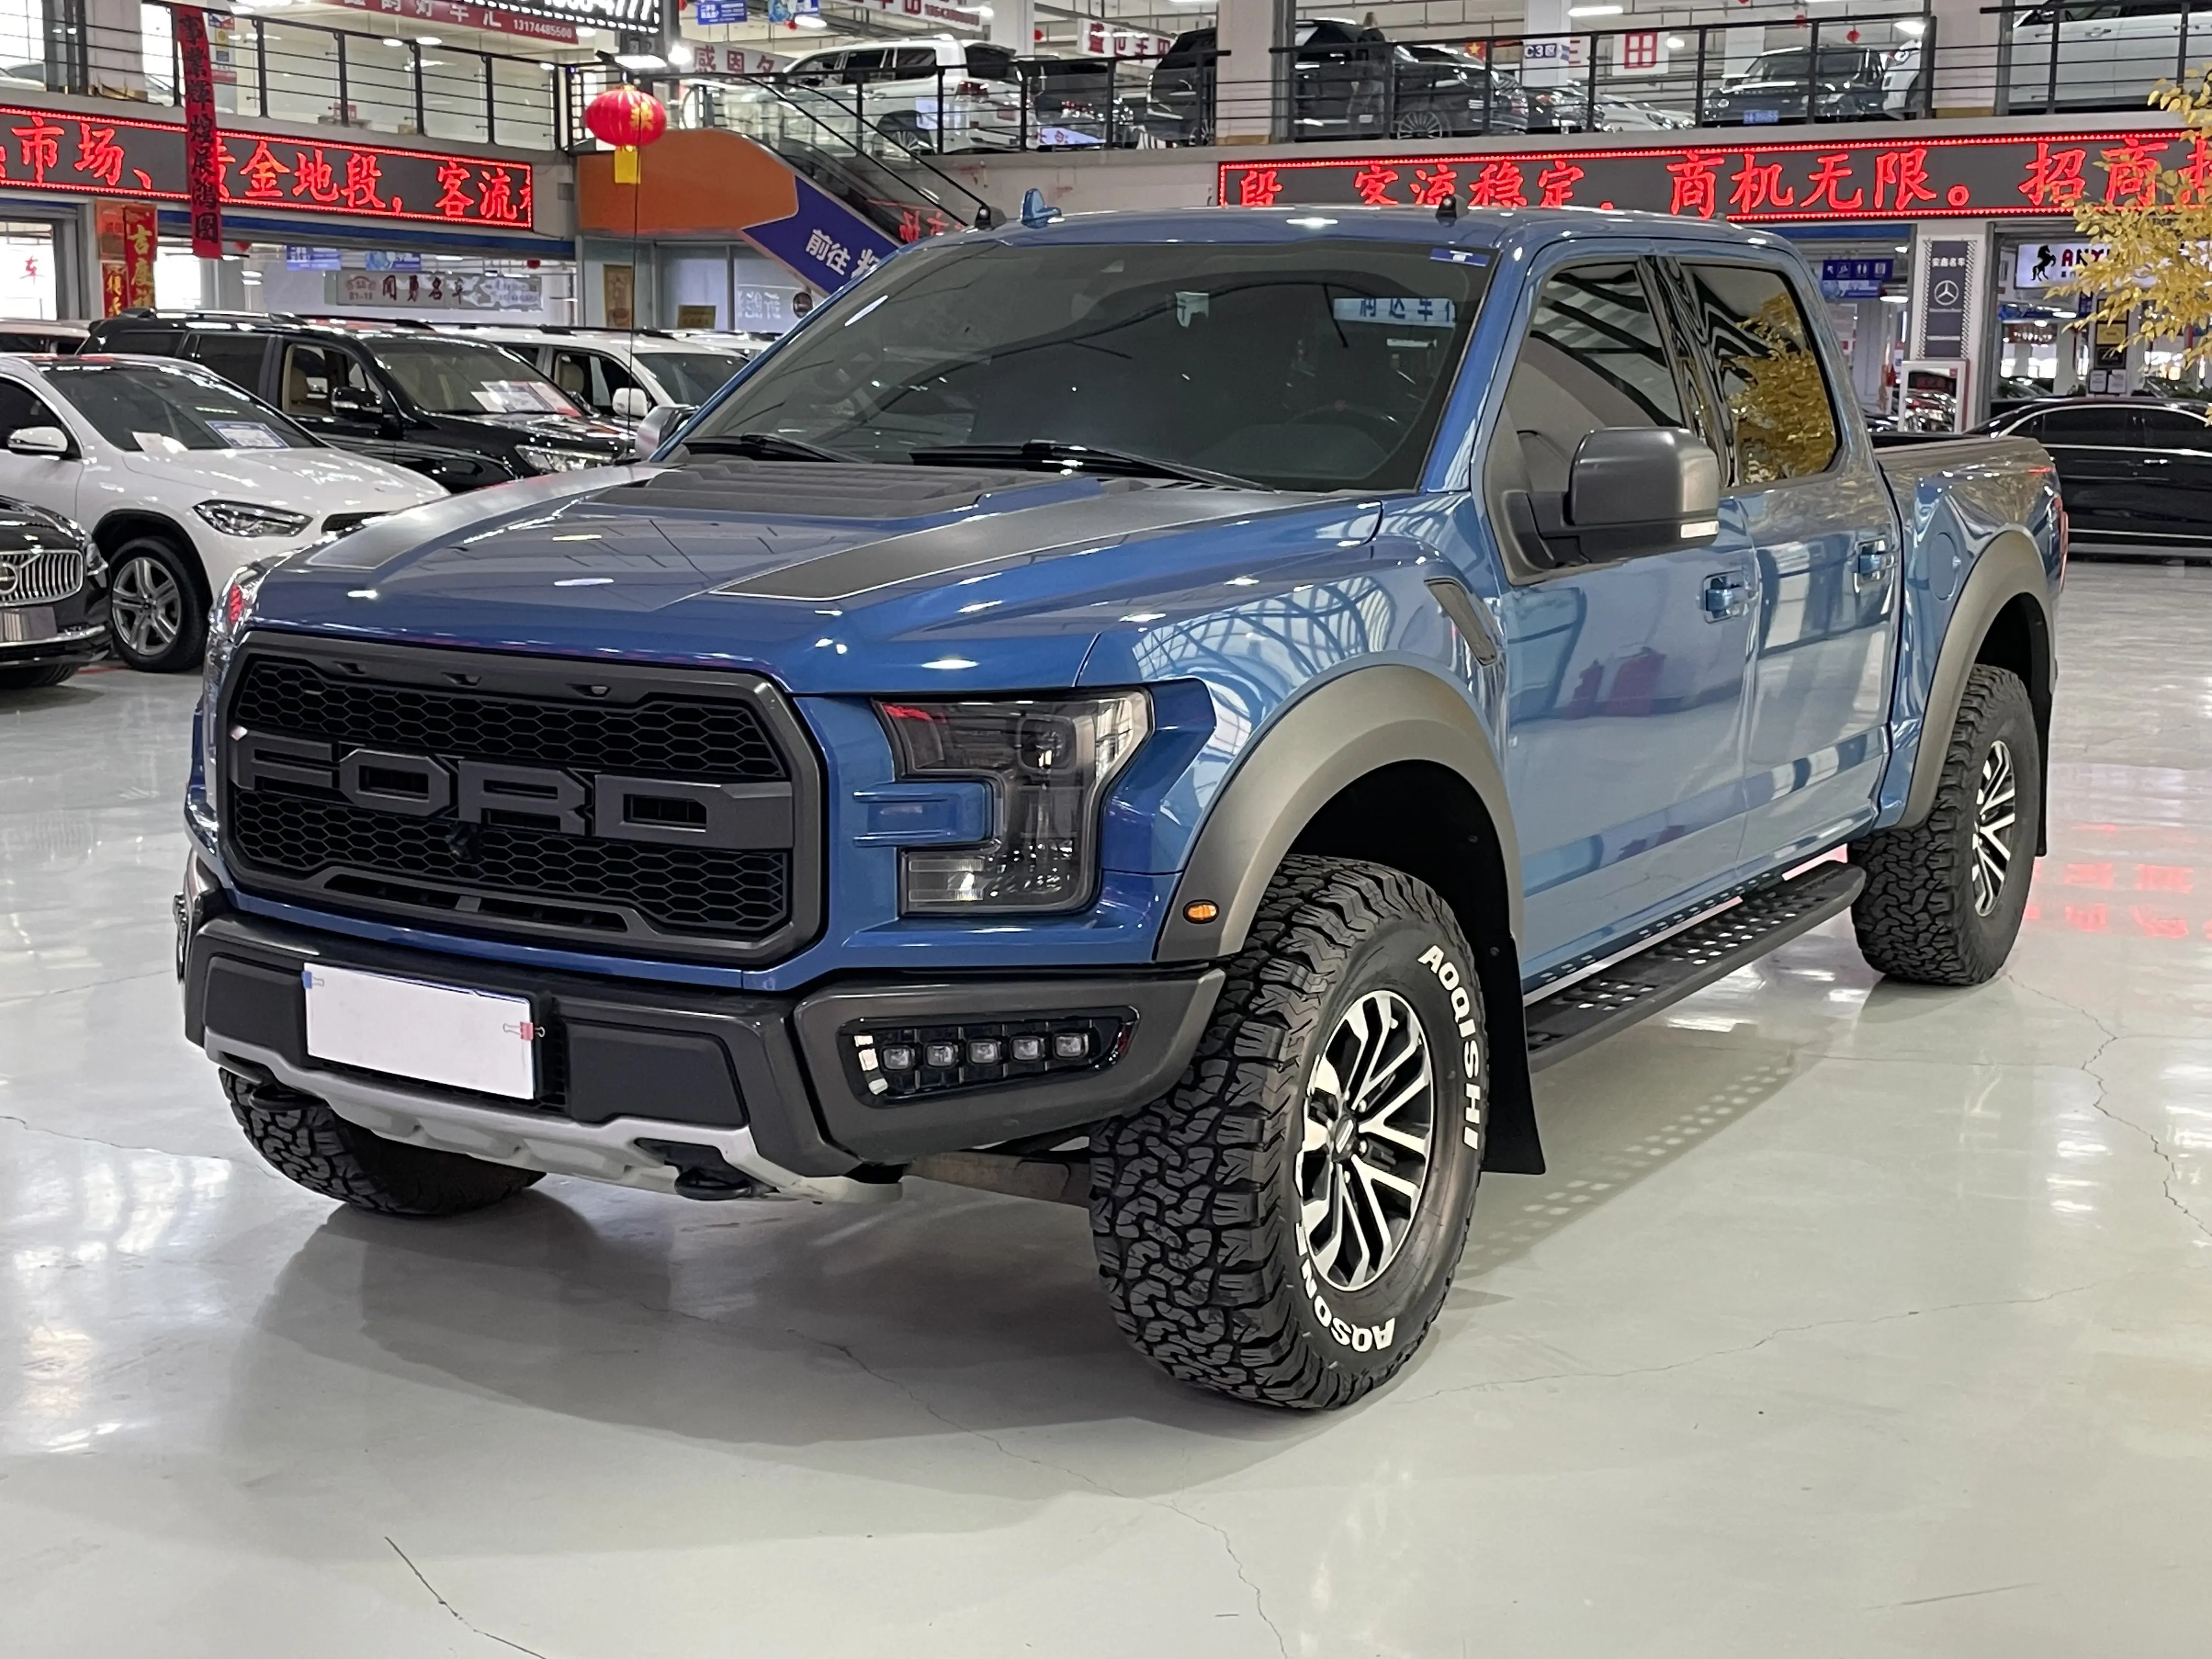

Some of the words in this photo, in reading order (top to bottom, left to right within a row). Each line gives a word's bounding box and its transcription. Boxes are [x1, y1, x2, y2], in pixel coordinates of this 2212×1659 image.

[514, 19, 573, 38] 13174485500
[232, 725, 741, 849] FORD
[1417, 944, 1481, 1150] AOQISHI
